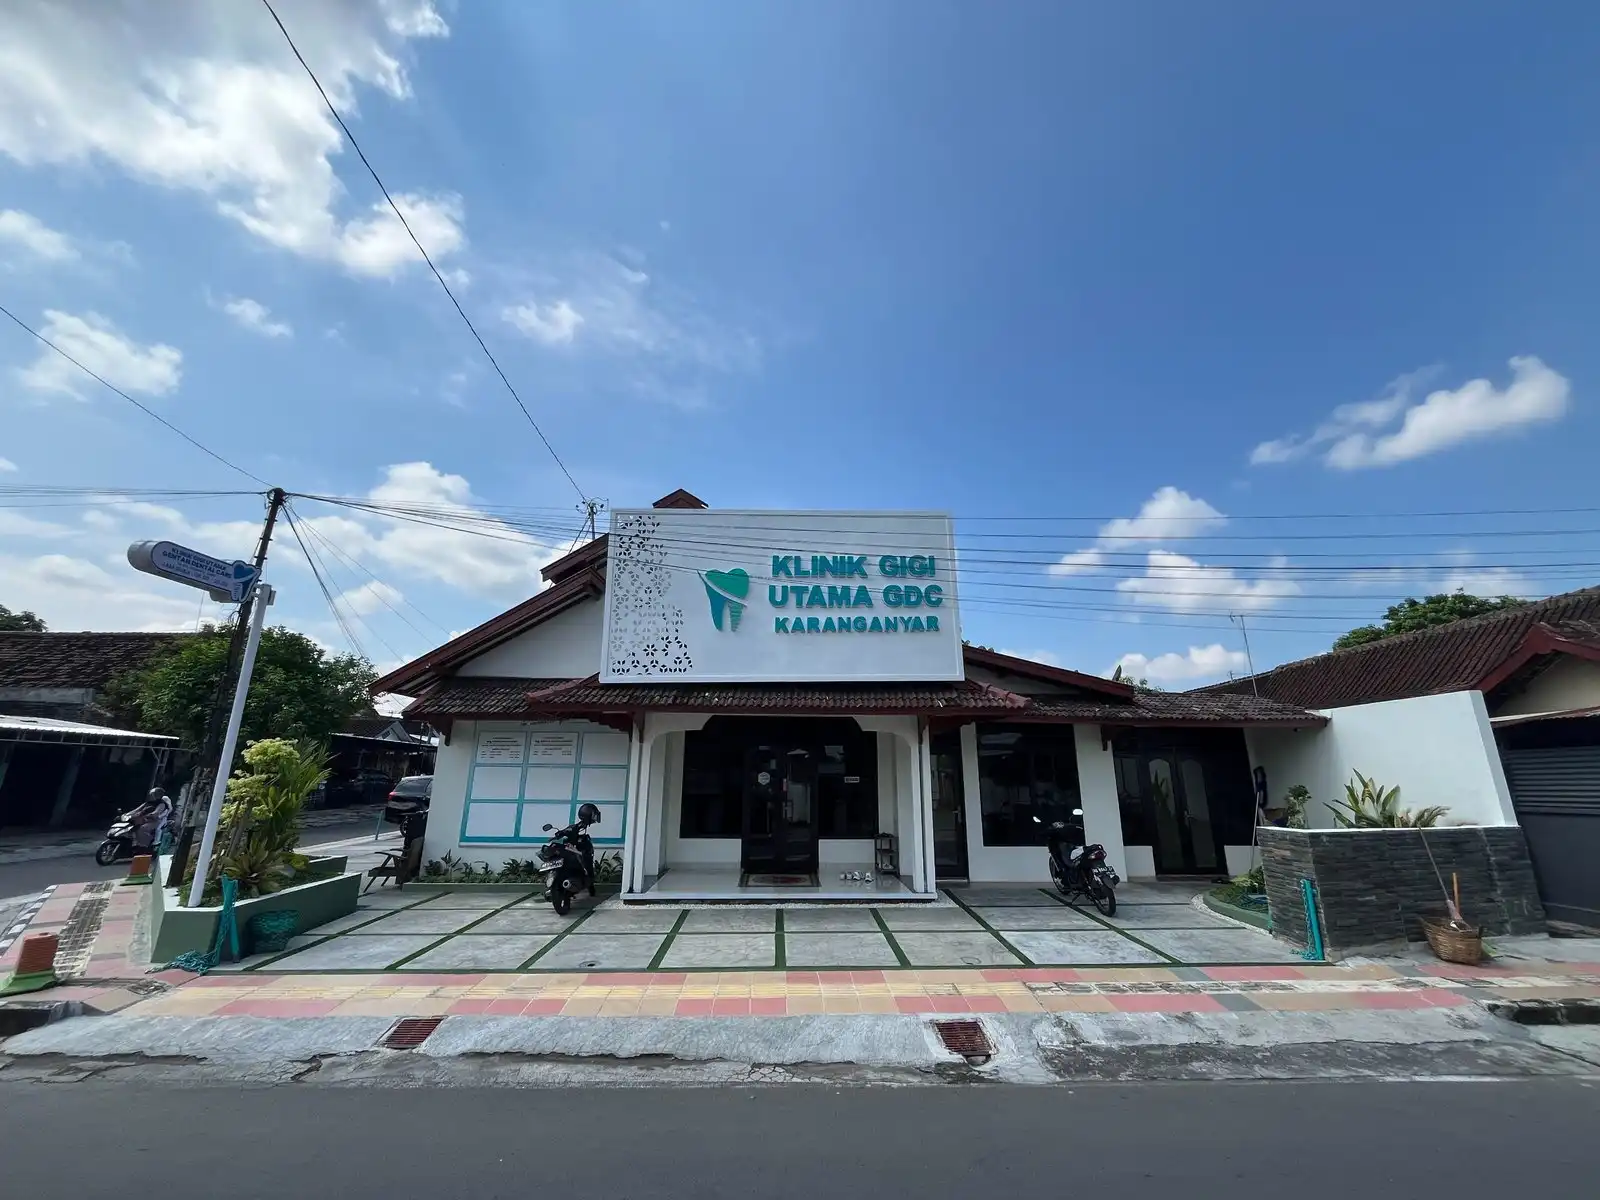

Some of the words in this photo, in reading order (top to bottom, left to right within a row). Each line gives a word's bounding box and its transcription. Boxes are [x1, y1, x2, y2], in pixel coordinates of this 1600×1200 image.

[191, 560, 215, 573] DENTAL
[772, 555, 868, 578] KLINIK
[879, 555, 935, 577] GIGI
[768, 585, 873, 608] UTAMA
[883, 585, 943, 607] GDC
[775, 616, 939, 633] KARANGANYAR
